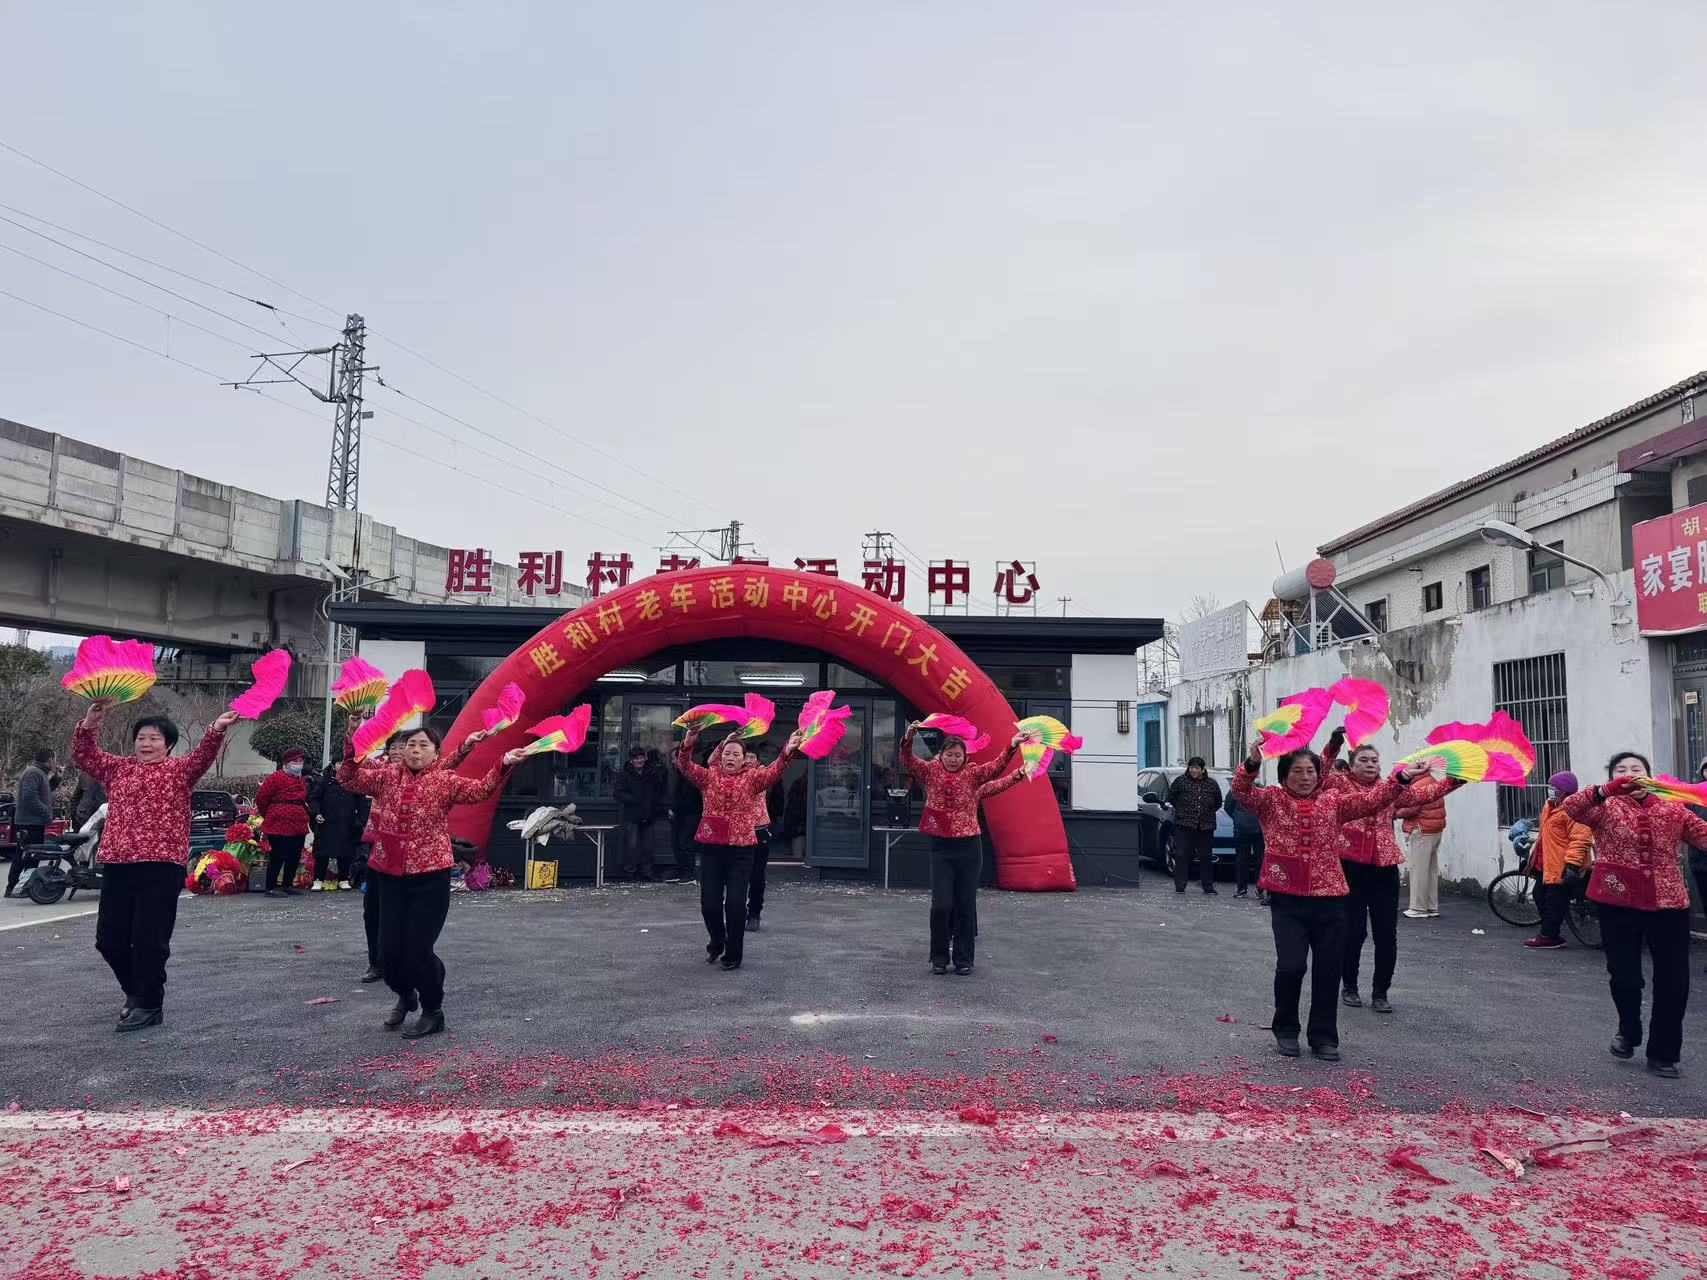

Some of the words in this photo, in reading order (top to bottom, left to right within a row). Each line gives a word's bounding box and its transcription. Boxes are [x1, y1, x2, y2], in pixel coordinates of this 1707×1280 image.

[445, 548, 1040, 606] 胜利村动中心
[529, 576, 973, 700] 胜利村老年活动中心开门大吉
